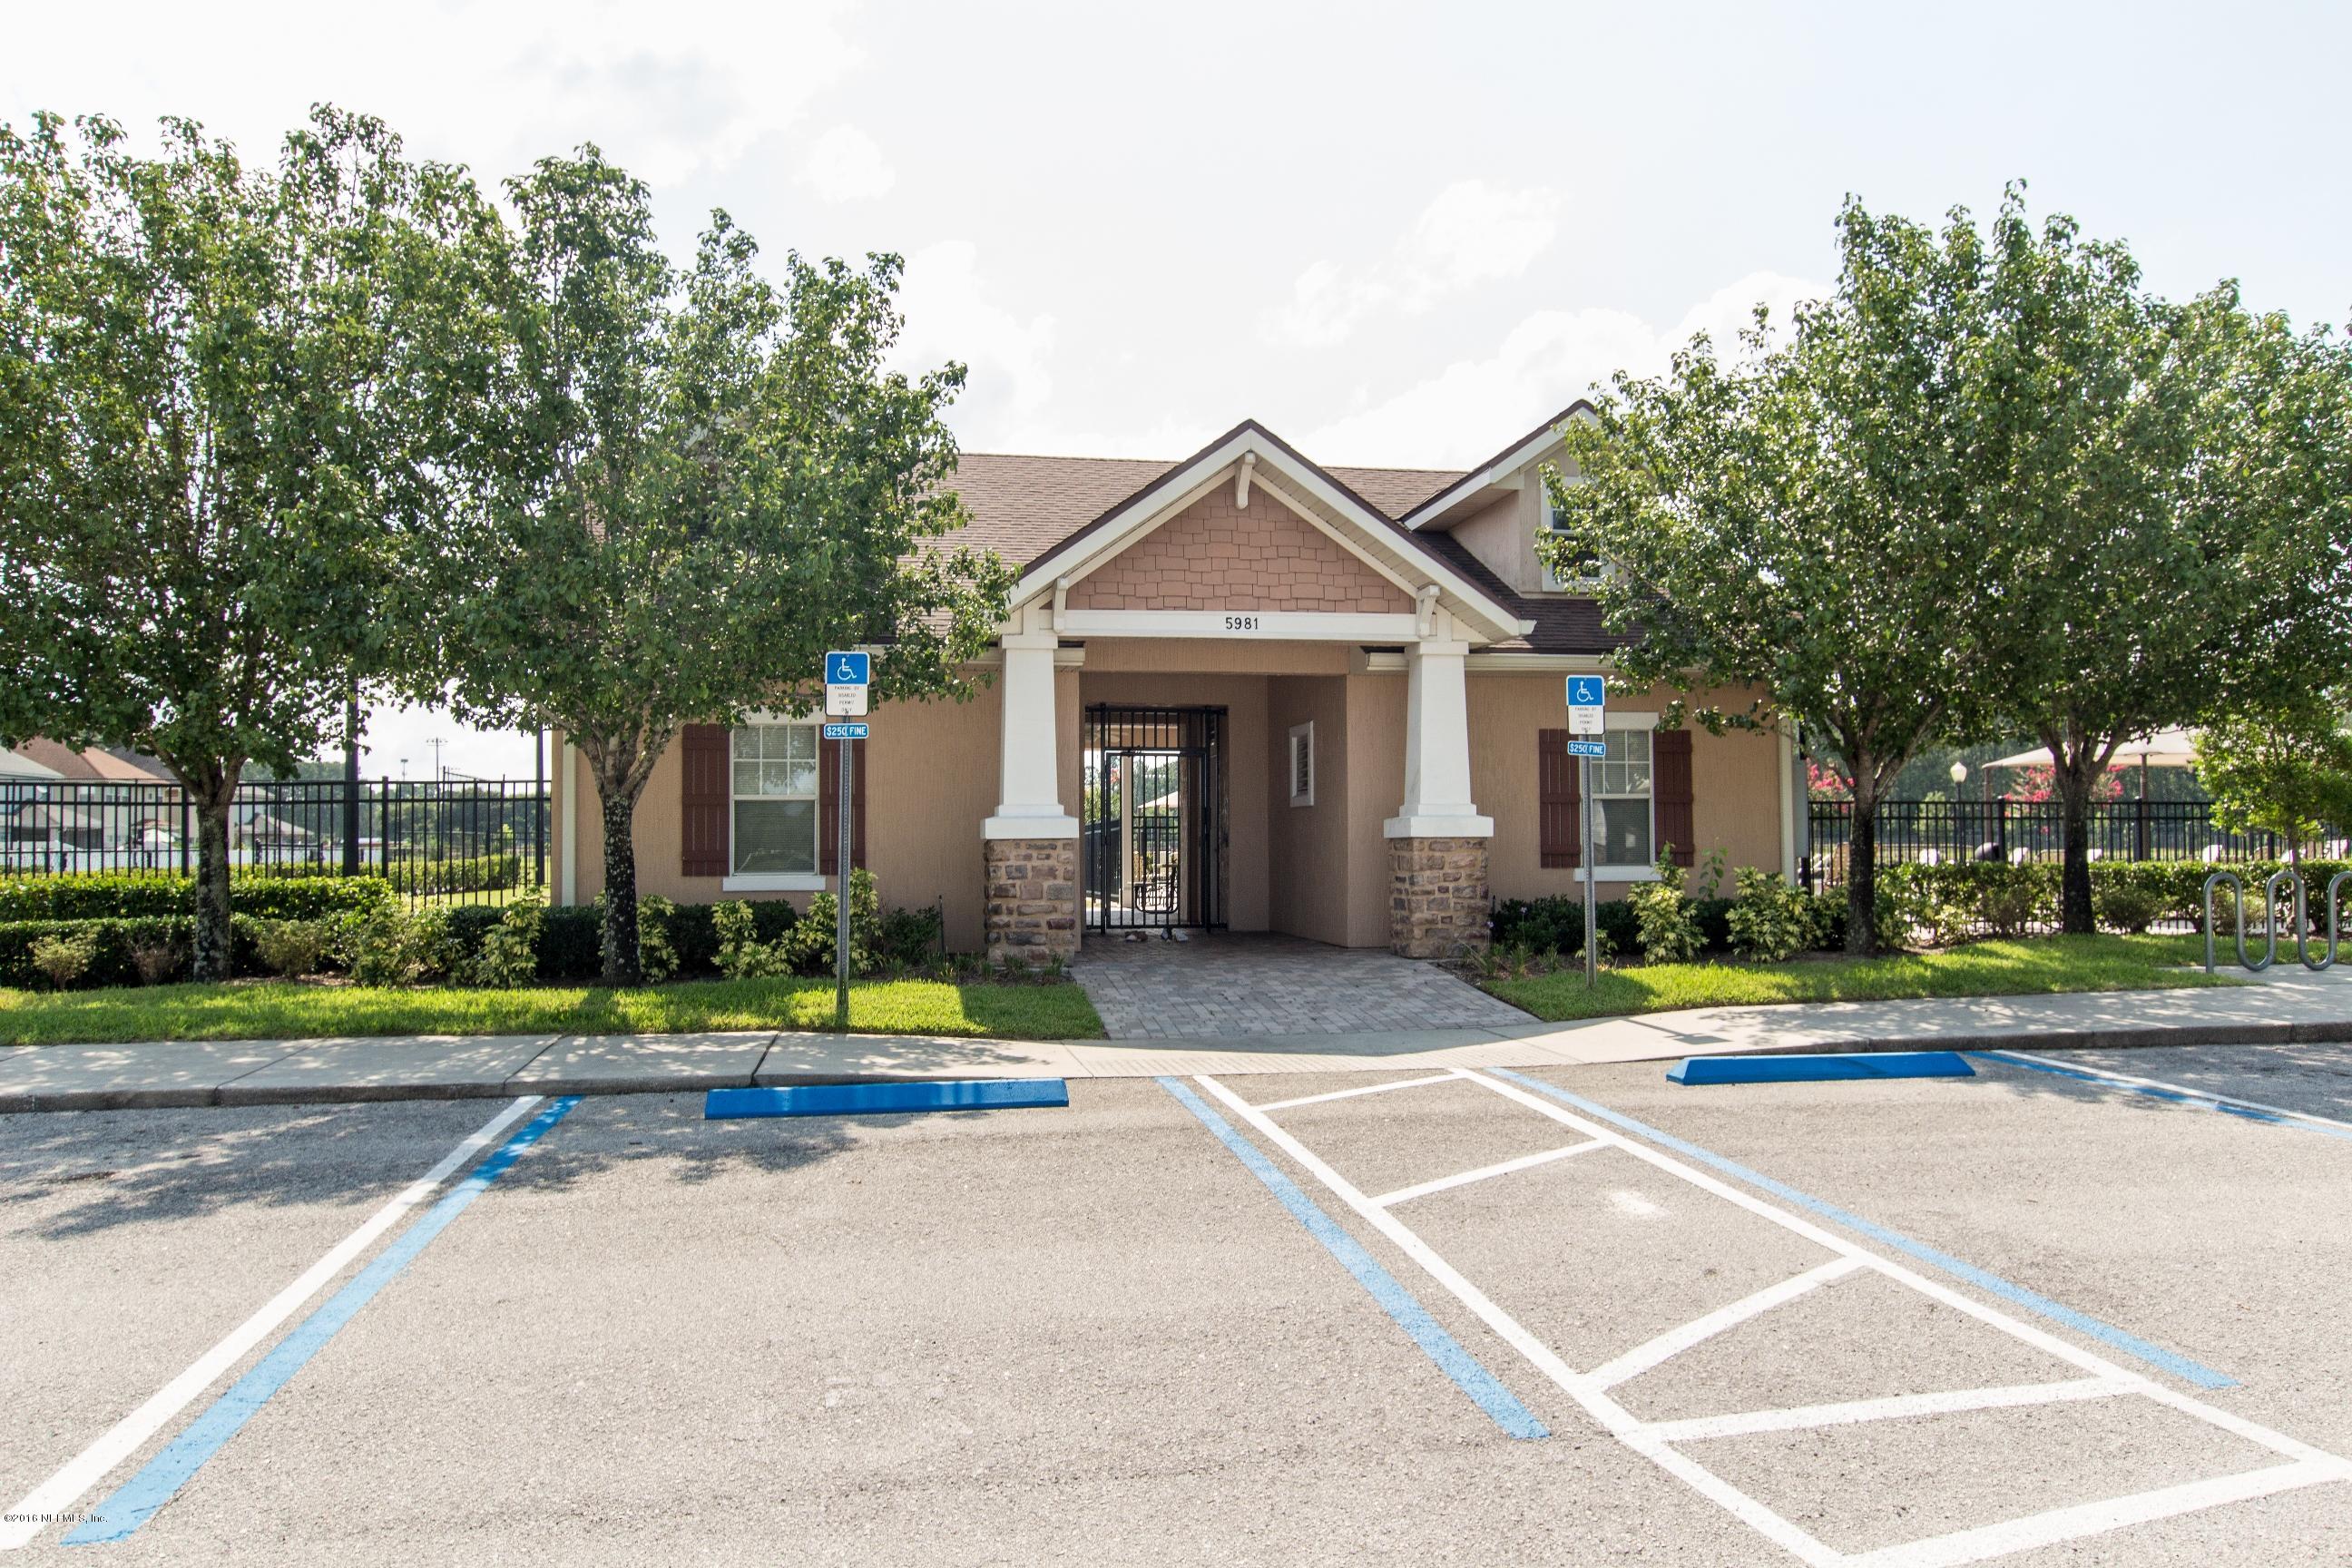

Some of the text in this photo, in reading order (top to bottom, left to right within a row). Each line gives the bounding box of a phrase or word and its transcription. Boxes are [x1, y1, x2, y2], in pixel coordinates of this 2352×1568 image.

[1226, 617, 1258, 630] 5981
[827, 726, 867, 737] $250 FINE
[1570, 743, 1603, 754] $250 FINE
